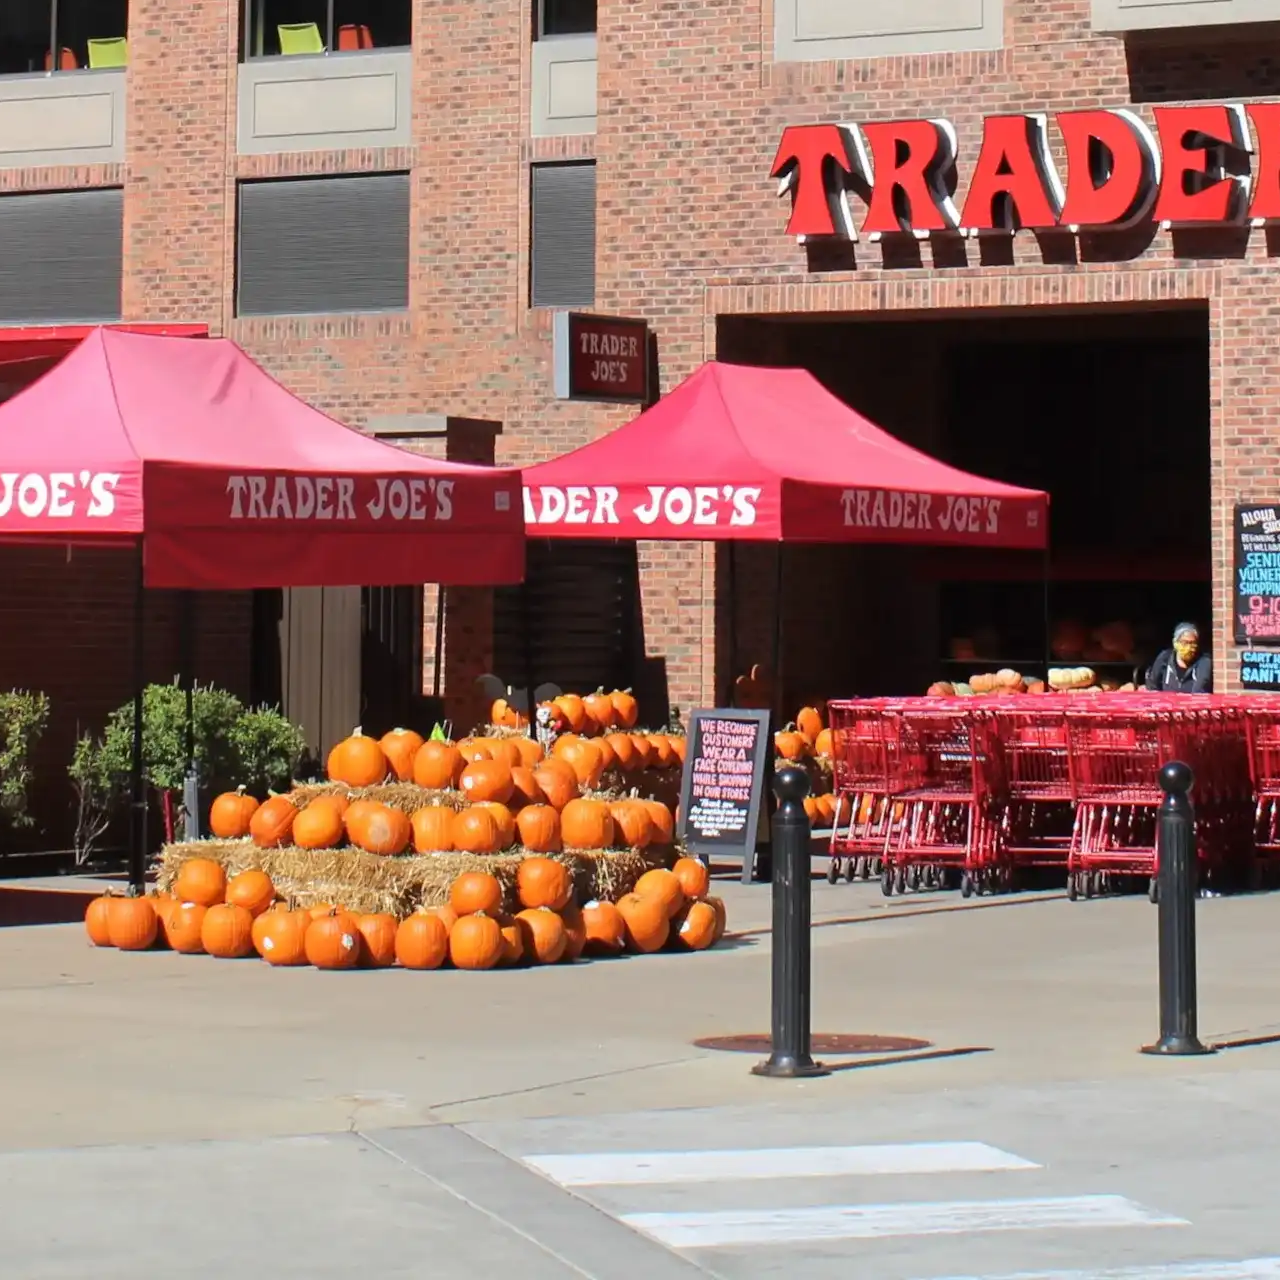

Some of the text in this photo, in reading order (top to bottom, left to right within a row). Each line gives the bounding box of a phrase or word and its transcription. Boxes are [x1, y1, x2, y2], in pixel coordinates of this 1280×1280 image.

[580, 332, 639, 358] TRADER
[591, 358, 627, 383] JOE'S
[226, 476, 357, 520] TRADER
[366, 478, 455, 520] JOE'S
[633, 485, 761, 526] JOE'S
[840, 489, 931, 530] TRADER
[937, 496, 1001, 535] JOE'S
[1241, 508, 1276, 527] ALOHA
[1243, 652, 1272, 662] CART
[700, 719, 758, 735] WE REQUIRE
[702, 732, 754, 748] CUSTOMERS
[702, 745, 746, 760] WEAR A
[694, 758, 717, 772] FACE
[693, 772, 717, 785] WHILE
[693, 785, 703, 796] IN
[704, 785, 720, 798] OUR
